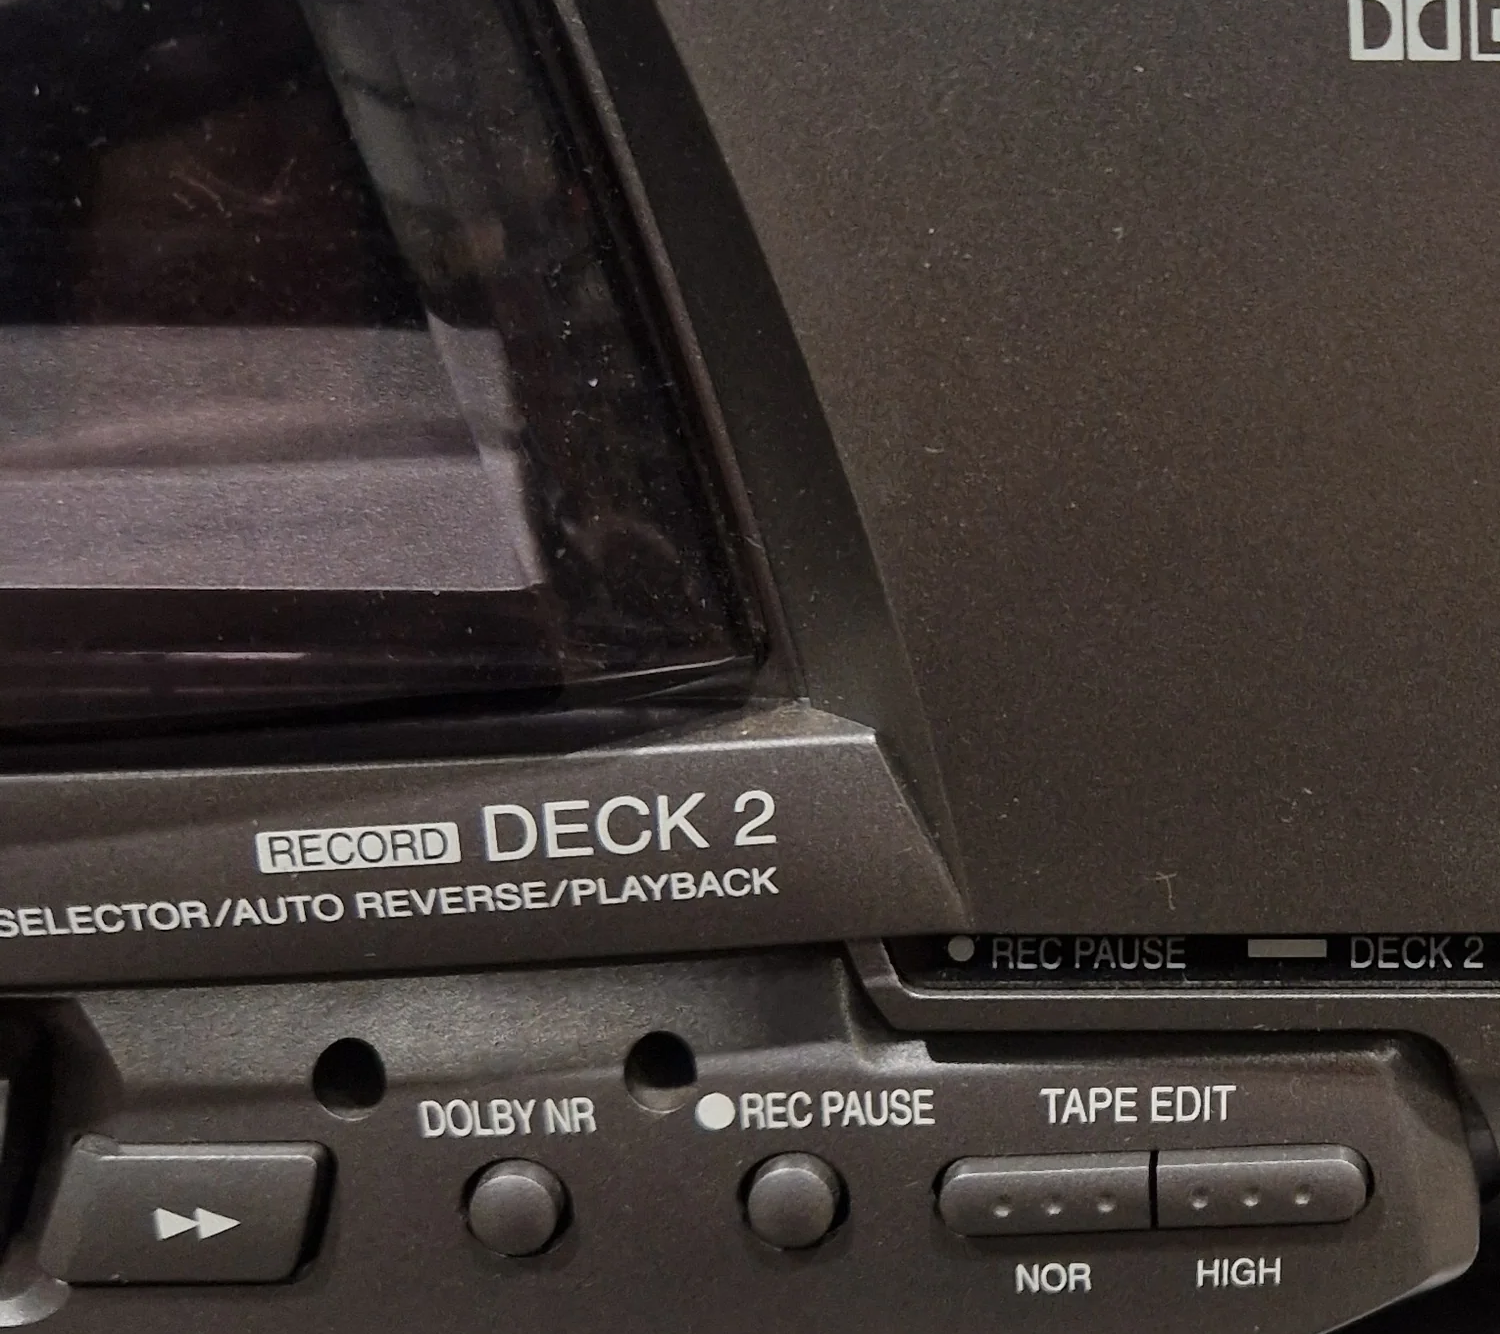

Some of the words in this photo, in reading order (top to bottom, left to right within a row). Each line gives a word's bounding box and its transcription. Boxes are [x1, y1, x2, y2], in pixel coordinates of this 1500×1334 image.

[267, 829, 449, 866] RECORD
[483, 792, 708, 862] DECK
[733, 789, 777, 847] 2
[356, 867, 779, 919] REVERSE/PLAYBACK
[991, 940, 1062, 970] REC
[1073, 938, 1187, 970] PAUSE
[1350, 938, 1453, 970] DECK
[1463, 938, 1485, 969] 2
[419, 1098, 536, 1138] DOLBY
[545, 1097, 597, 1133] NR
[741, 1091, 813, 1130] REC
[822, 1087, 936, 1129] PAUSE
[1040, 1087, 1138, 1125] TAPE
[1150, 1084, 1237, 1124] EDIT
[1014, 1263, 1093, 1294] NOR
[1195, 1258, 1282, 1289] HIGH
